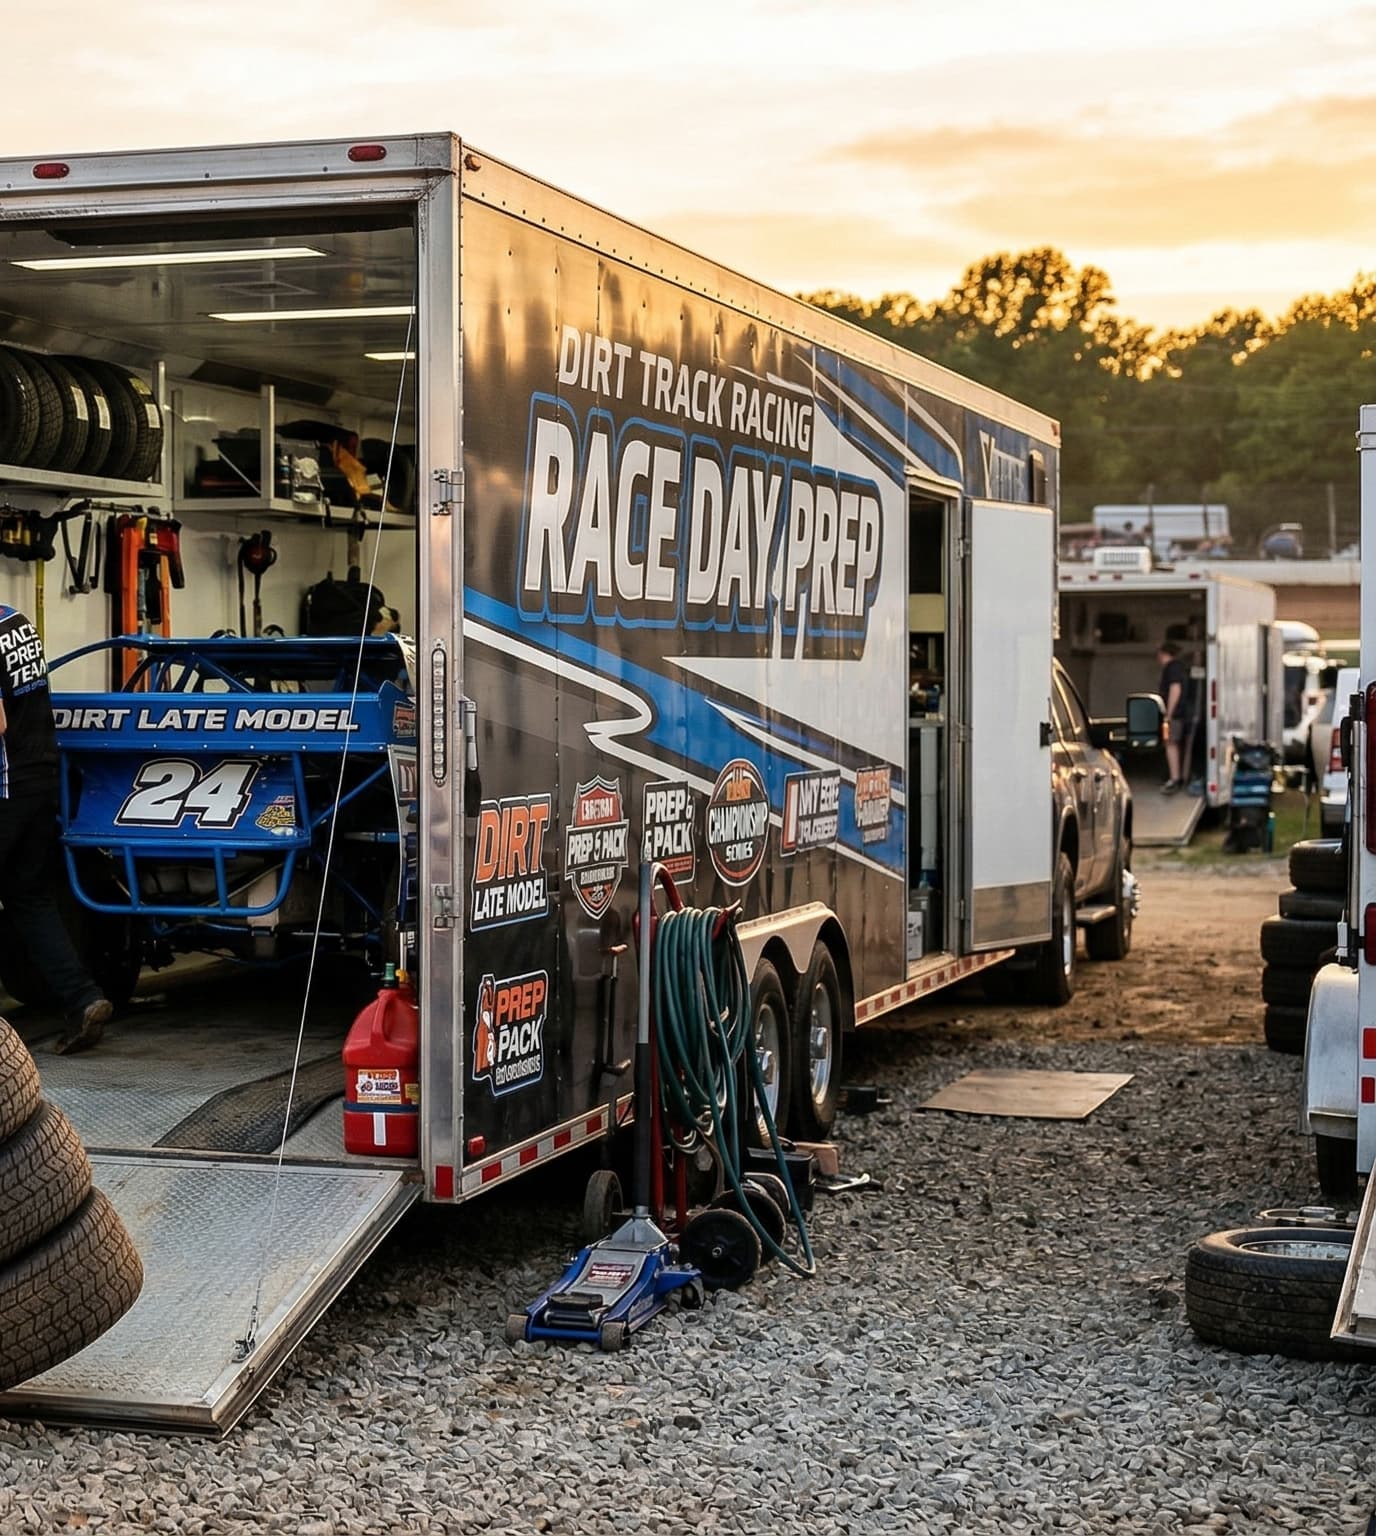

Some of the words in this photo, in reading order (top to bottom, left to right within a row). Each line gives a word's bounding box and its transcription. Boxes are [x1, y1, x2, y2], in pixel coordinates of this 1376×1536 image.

[558, 324, 632, 400] DIRT
[639, 350, 727, 429] TRACK
[729, 381, 815, 453] RACING
[524, 416, 682, 603] RACE
[686, 457, 782, 611] DAY
[785, 480, 881, 618] PREP
[5, 639, 43, 673] PREP
[51, 708, 131, 729] DIRT
[137, 708, 228, 729] LATE
[235, 708, 359, 731] MODEL
[118, 760, 257, 824] 24
[646, 788, 686, 825] PREP
[475, 803, 549, 884] DIRT
[567, 831, 594, 866] PREP
[653, 821, 693, 858] PACK
[474, 885, 505, 921] LATE
[506, 877, 547, 915] MODEL
[495, 979, 546, 1027] PREP
[497, 1013, 544, 1063] PACK
